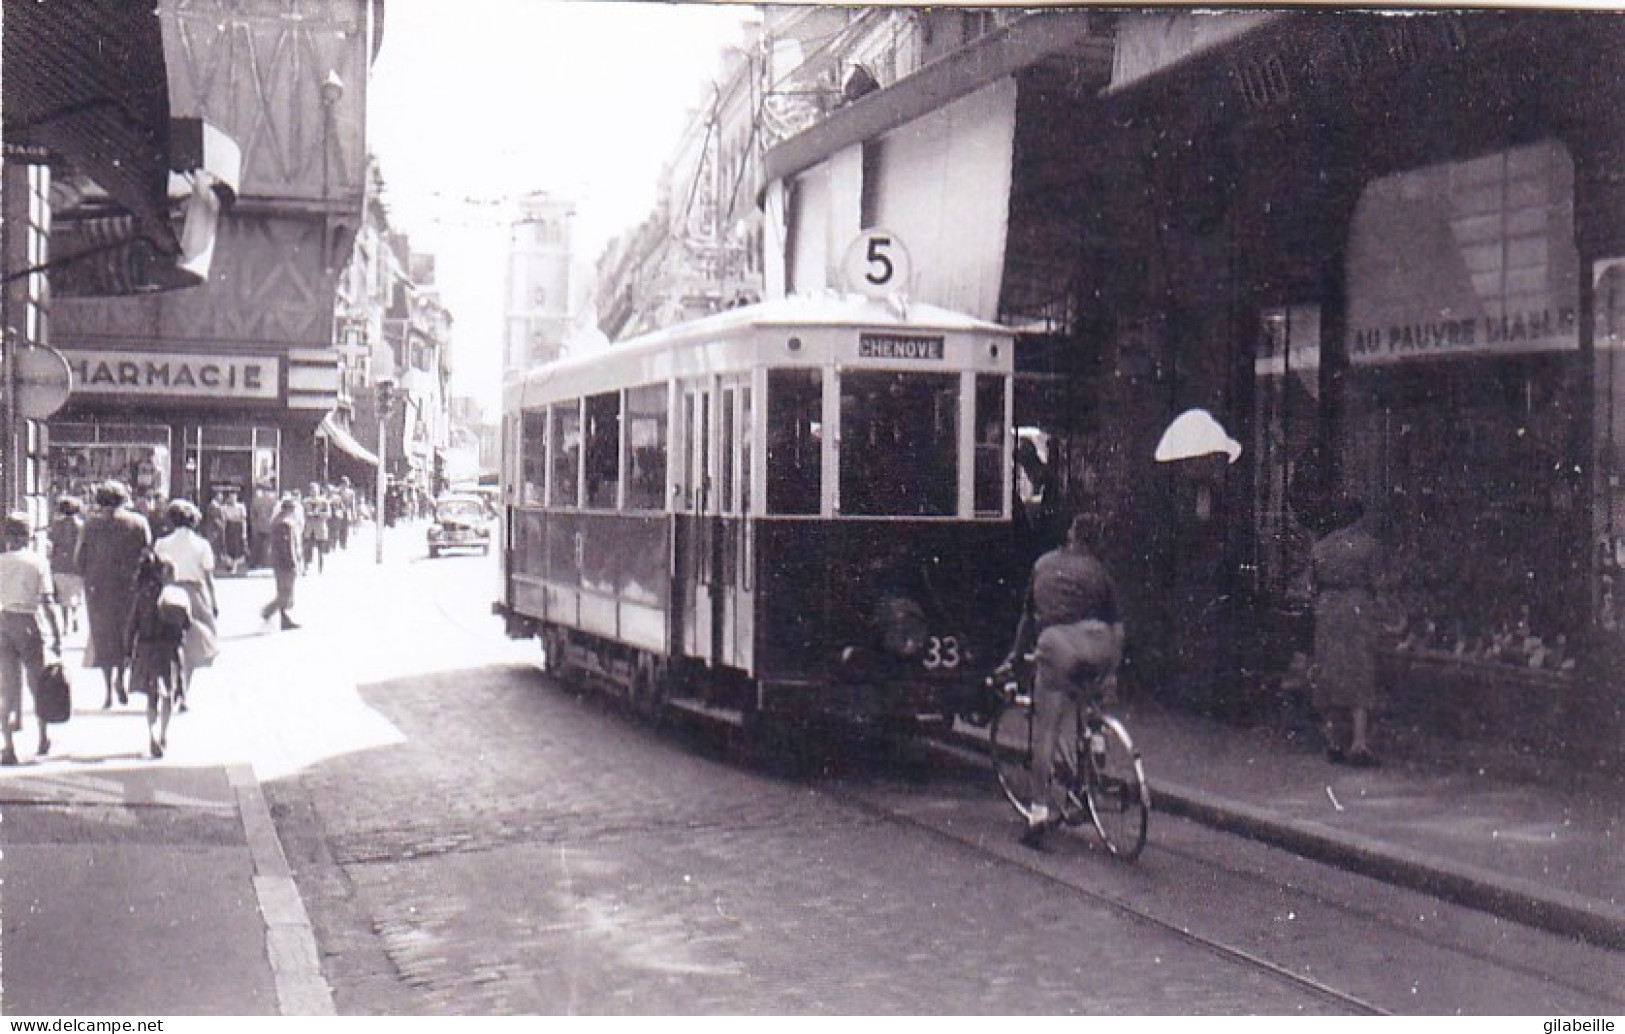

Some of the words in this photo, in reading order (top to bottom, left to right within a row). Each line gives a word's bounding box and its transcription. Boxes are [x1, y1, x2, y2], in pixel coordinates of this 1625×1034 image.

[865, 237, 893, 285] 5
[1353, 326, 1380, 354] AU
[1389, 317, 1476, 351] PAUVRE
[69, 359, 261, 389] HARMACIE
[922, 636, 959, 668] 33
